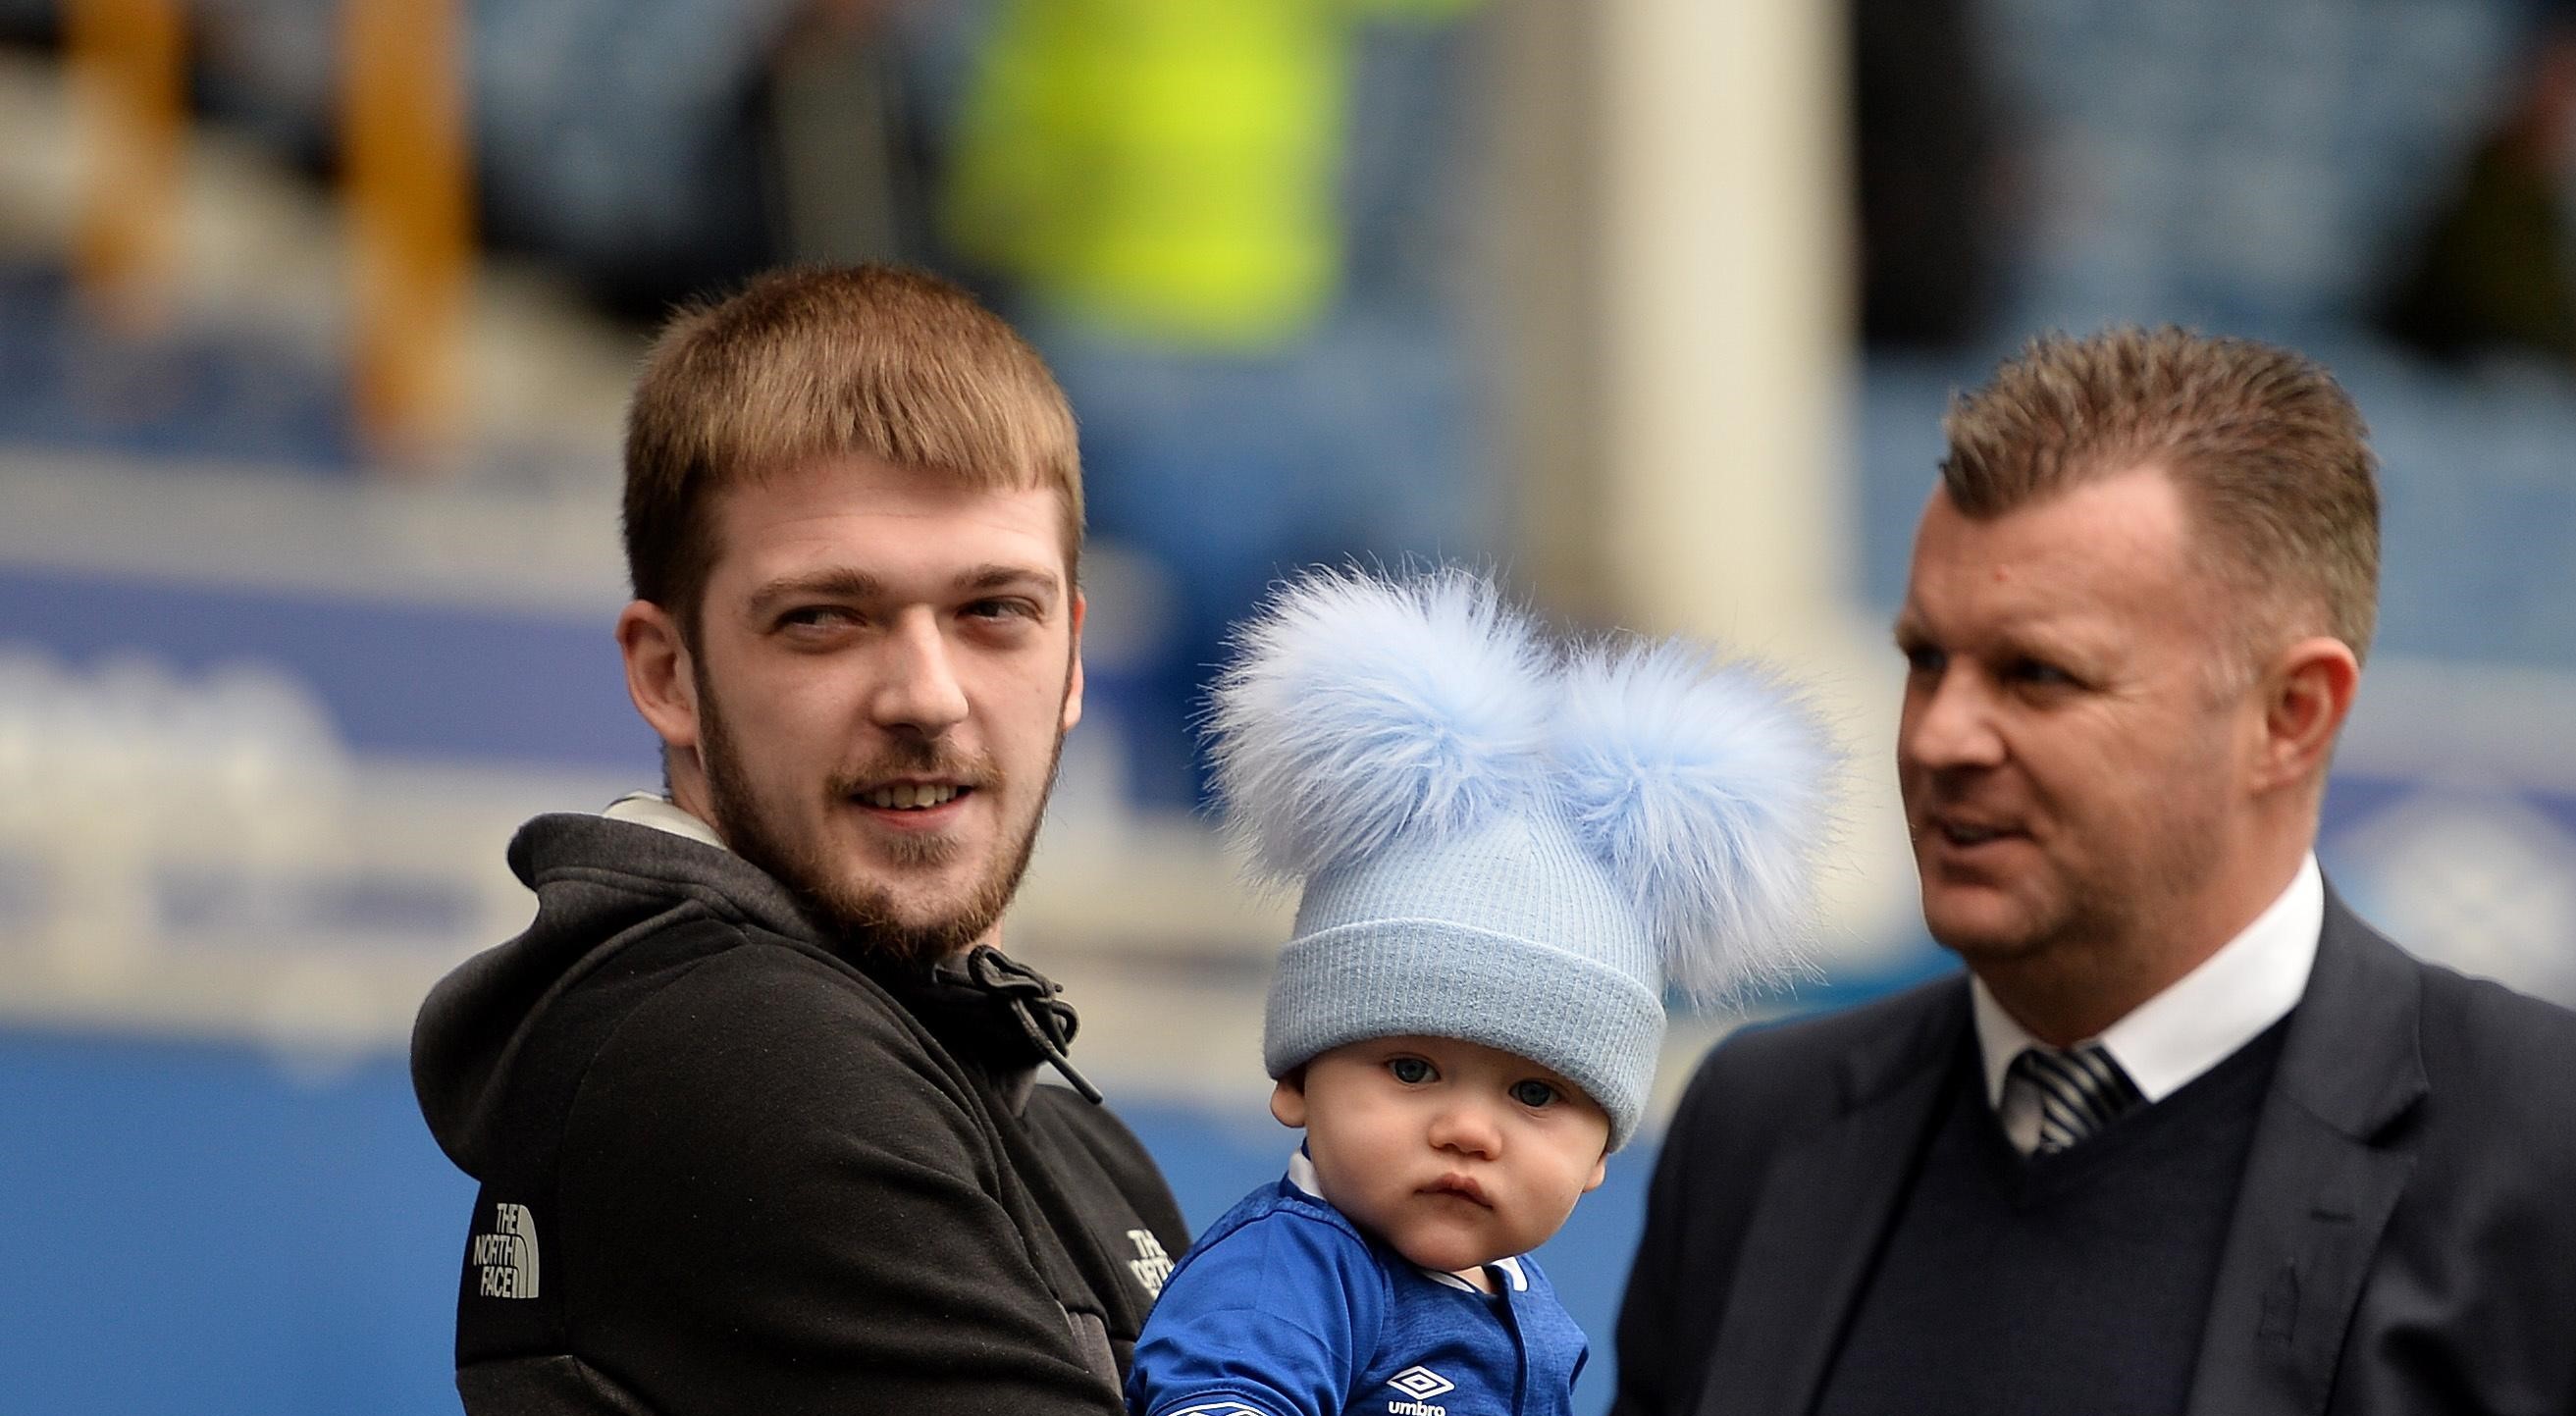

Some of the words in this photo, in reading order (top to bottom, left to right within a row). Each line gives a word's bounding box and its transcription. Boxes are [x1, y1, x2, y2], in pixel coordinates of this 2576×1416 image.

[497, 1203, 518, 1234] THE
[473, 1234, 514, 1266] NORTH
[480, 1266, 512, 1298] FACE
[1388, 1400, 1446, 1416] umbro
